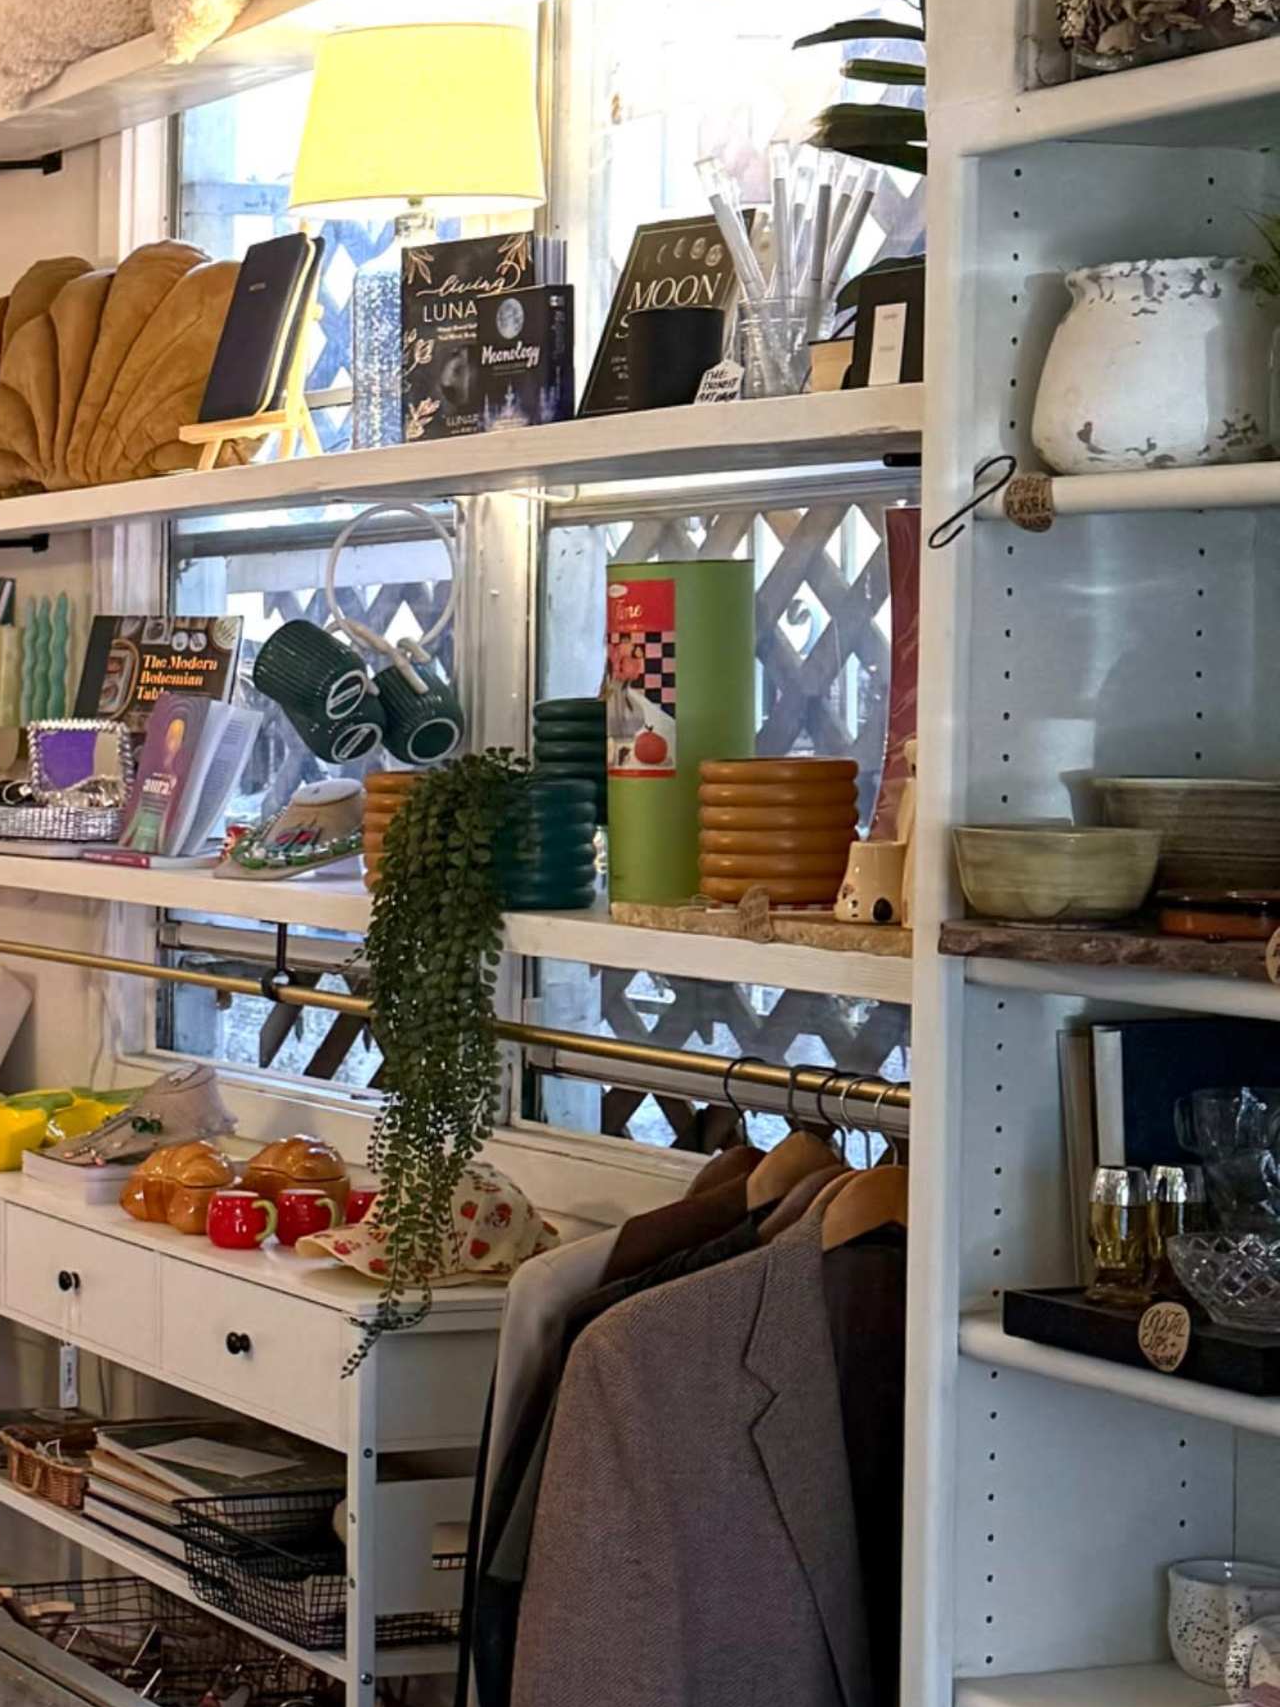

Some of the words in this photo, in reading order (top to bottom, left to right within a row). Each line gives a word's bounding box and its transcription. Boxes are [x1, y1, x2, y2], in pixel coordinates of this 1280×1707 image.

[627, 272, 723, 310] MOON
[423, 300, 479, 323] LUNA
[480, 341, 541, 368] Moonology
[143, 654, 168, 669] The
[169, 655, 218, 671] Modern
[140, 670, 204, 687] Bohemian
[136, 685, 171, 701] Tab
